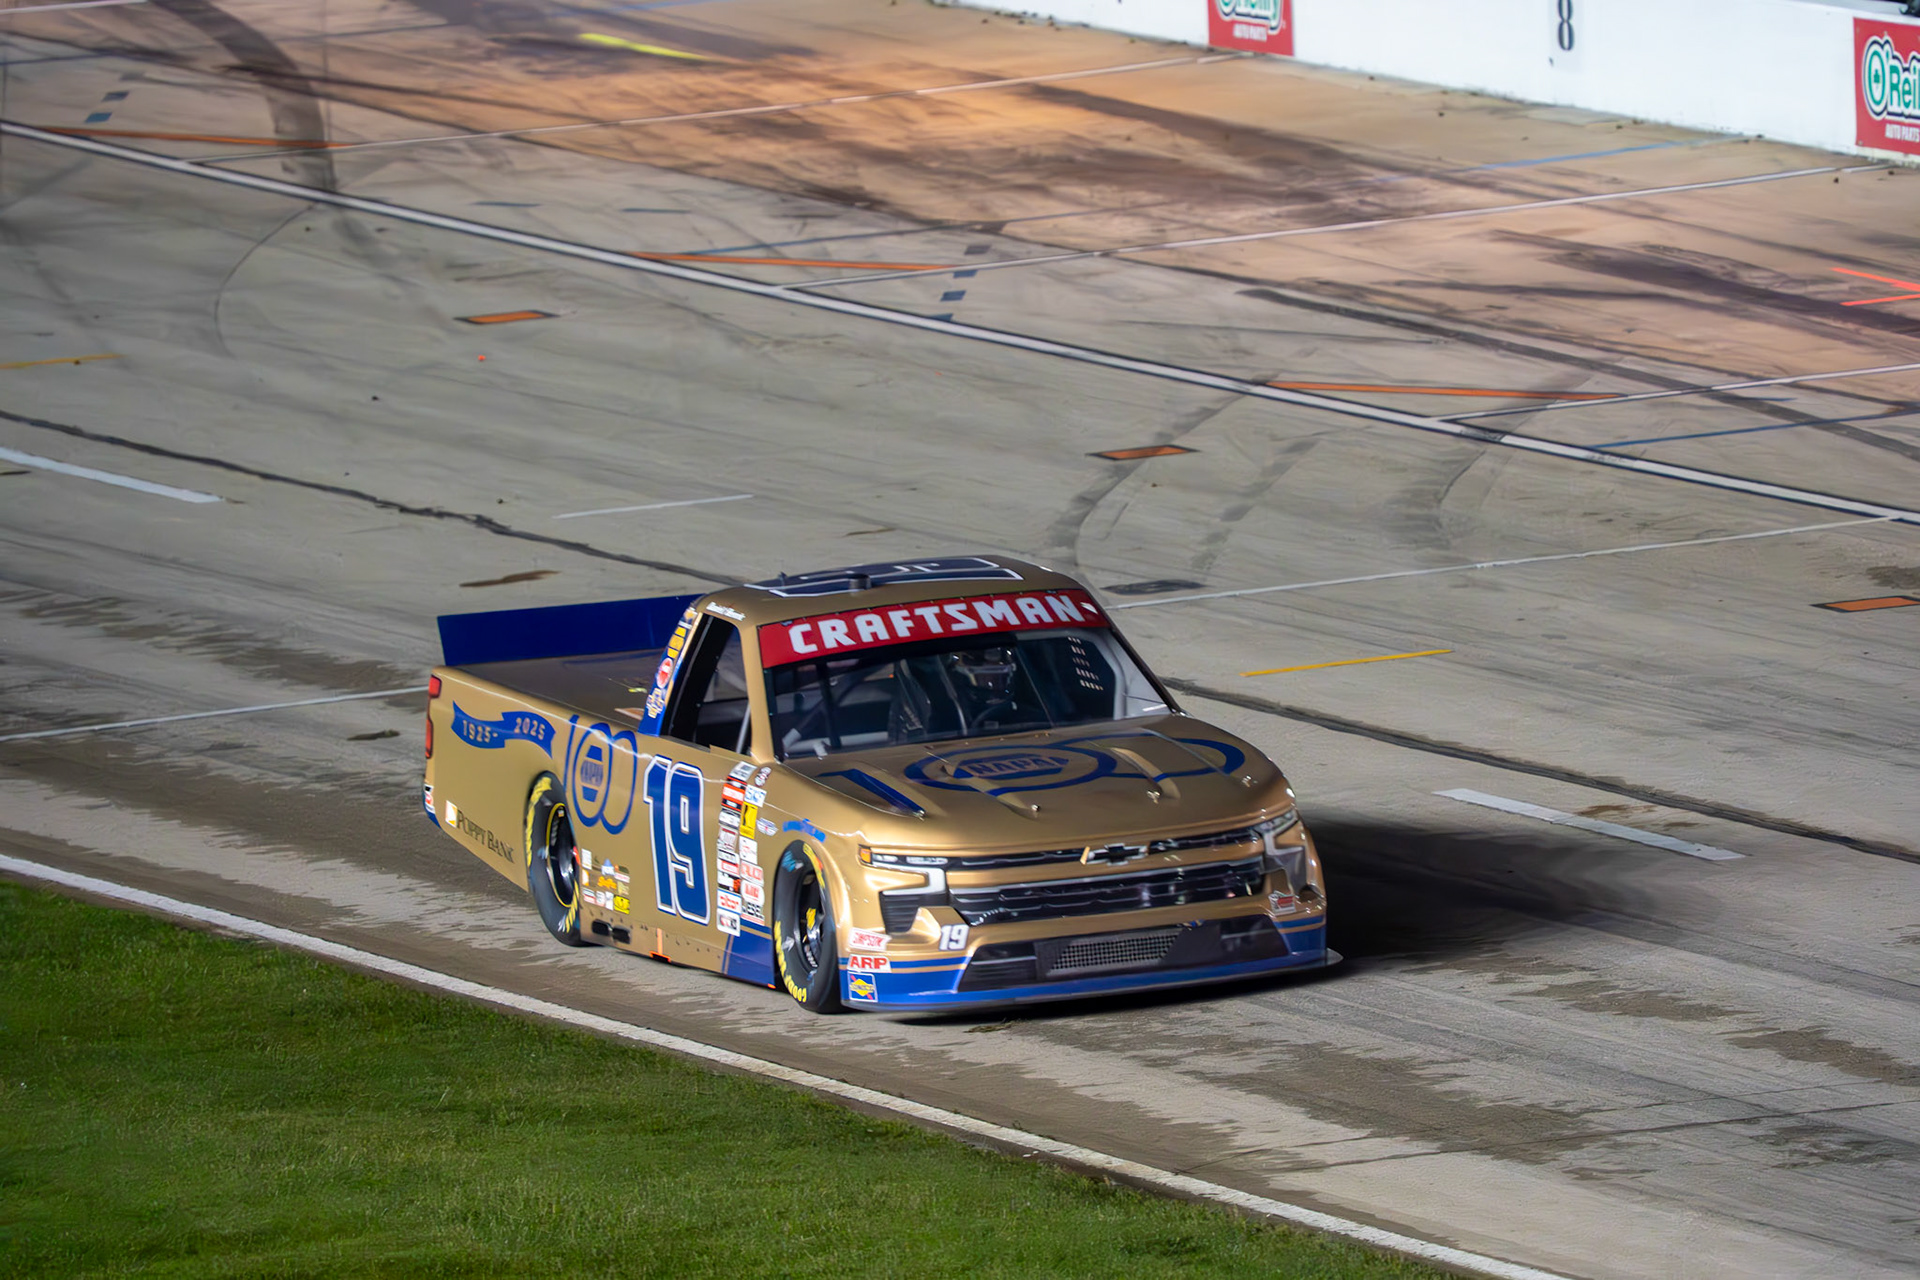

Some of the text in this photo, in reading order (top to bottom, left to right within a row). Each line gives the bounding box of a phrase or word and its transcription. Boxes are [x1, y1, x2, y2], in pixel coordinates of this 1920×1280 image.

[788, 594, 1085, 655] CRAFTSMAN
[514, 717, 546, 740] 2025
[961, 755, 1062, 778] NAPA
[457, 808, 487, 846] POPPY
[487, 829, 515, 864] BANK
[643, 754, 711, 926] 19
[938, 923, 970, 951] 19
[850, 955, 888, 970] ARP
